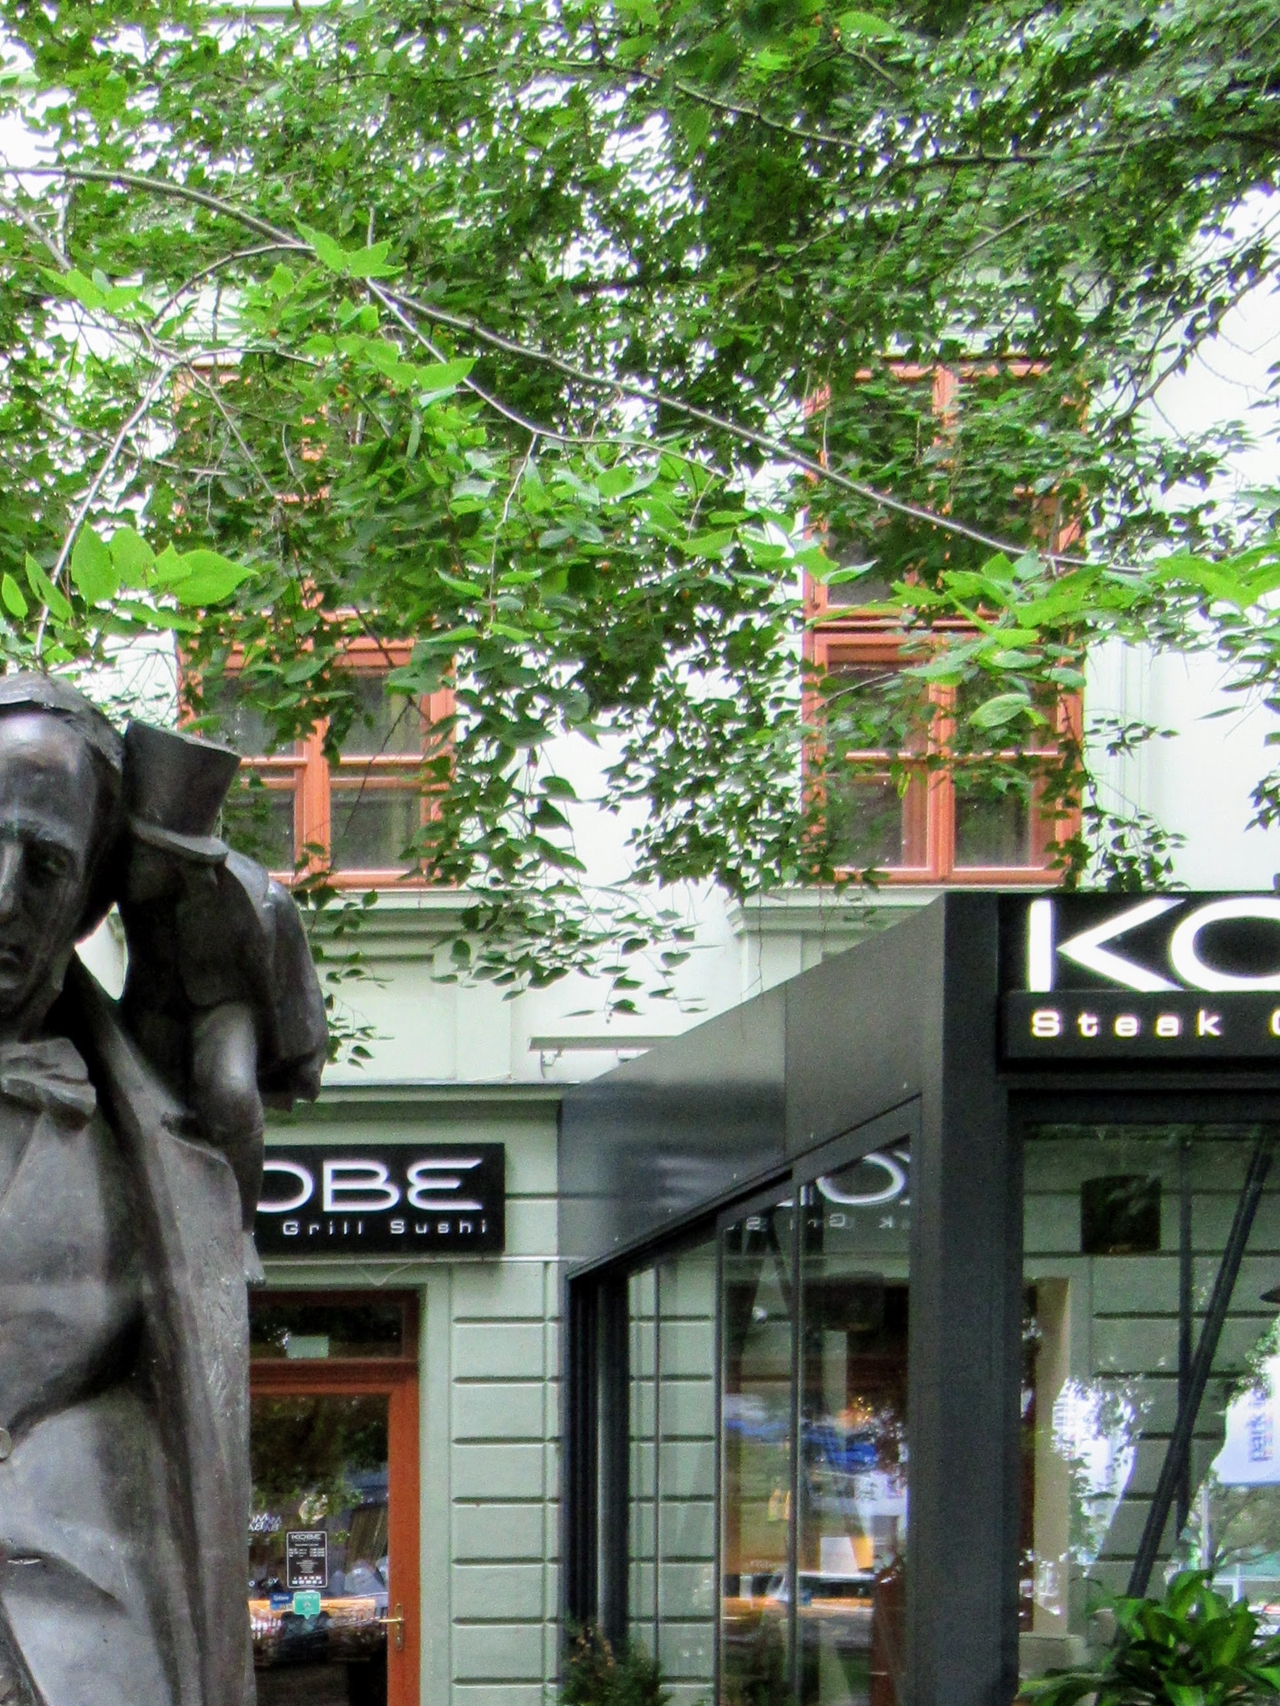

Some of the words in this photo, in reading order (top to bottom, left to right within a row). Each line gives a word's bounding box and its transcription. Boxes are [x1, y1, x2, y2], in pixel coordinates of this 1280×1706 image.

[1030, 1008, 1222, 1038] Steak
[282, 1219, 364, 1236] Grill
[389, 1219, 488, 1235] Sushi
